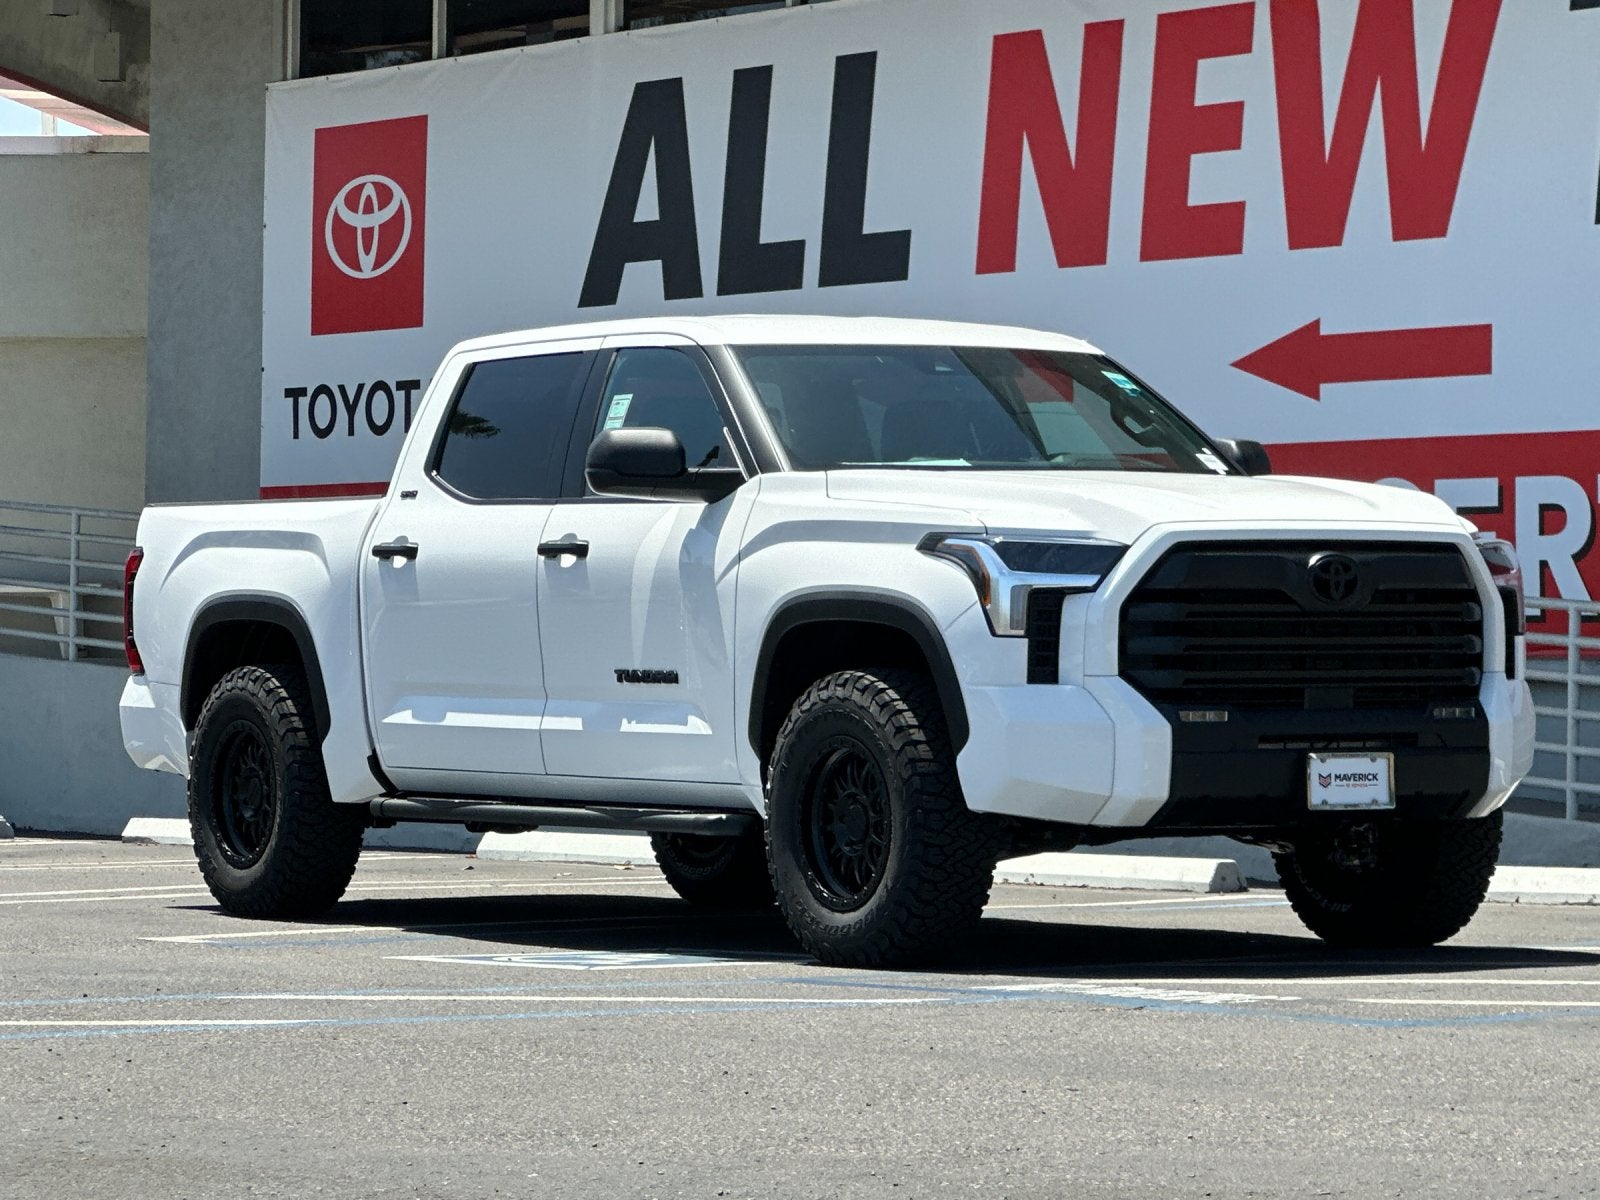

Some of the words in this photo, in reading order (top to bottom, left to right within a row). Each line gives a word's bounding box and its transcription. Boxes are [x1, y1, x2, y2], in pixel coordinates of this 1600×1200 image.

[578, 51, 912, 308] ALL
[974, 0, 1501, 275] NEW
[284, 379, 428, 439] TOYOT
[1334, 773, 1379, 782] MAVERICK
